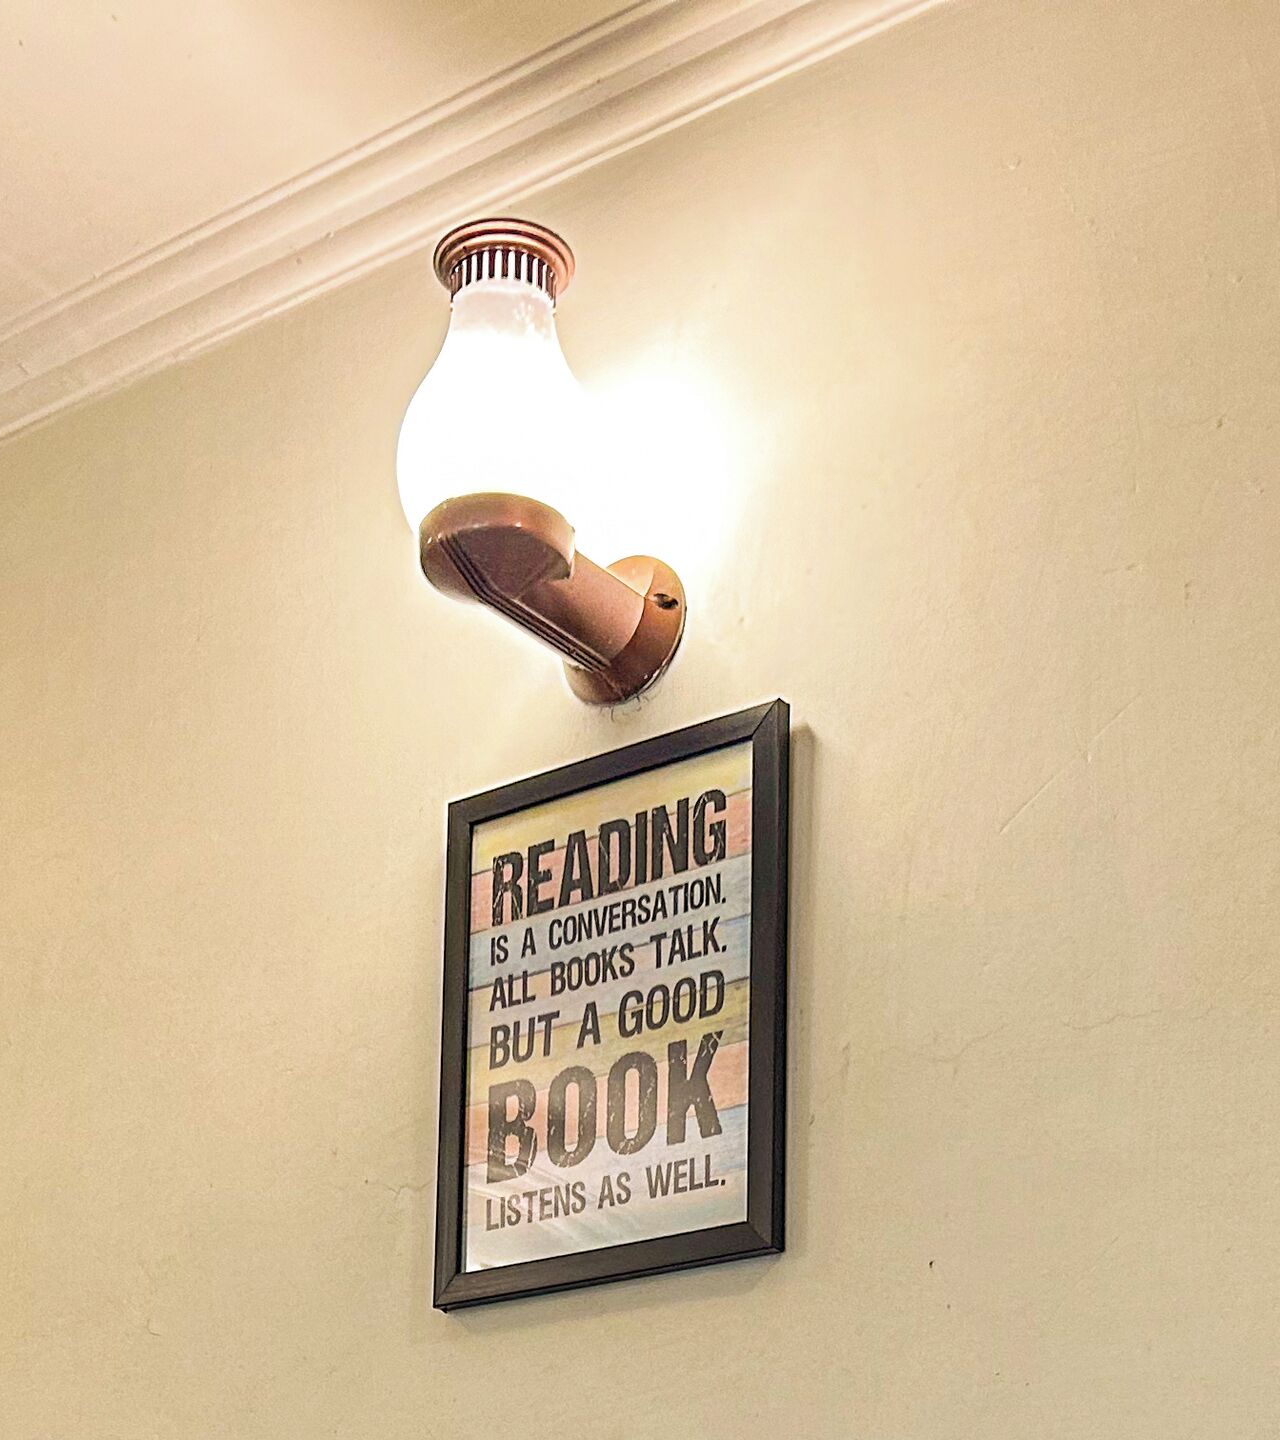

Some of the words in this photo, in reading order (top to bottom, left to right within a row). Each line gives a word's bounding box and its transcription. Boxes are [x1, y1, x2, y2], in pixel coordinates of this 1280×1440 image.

[492, 789, 727, 926] READING
[489, 972, 536, 1012] ALL
[551, 945, 634, 997] BOOKS
[650, 917, 727, 969] TALK.
[490, 934, 508, 966] IS
[521, 927, 536, 956] A
[549, 874, 726, 947] CONVERSATION.
[489, 1011, 560, 1070] BUT
[577, 1001, 601, 1049] A
[619, 970, 725, 1037] GOOD
[486, 1031, 724, 1183] BOOK
[486, 1181, 585, 1231] LISTENS
[598, 1173, 631, 1209] AS
[646, 1155, 726, 1199] WELL.
